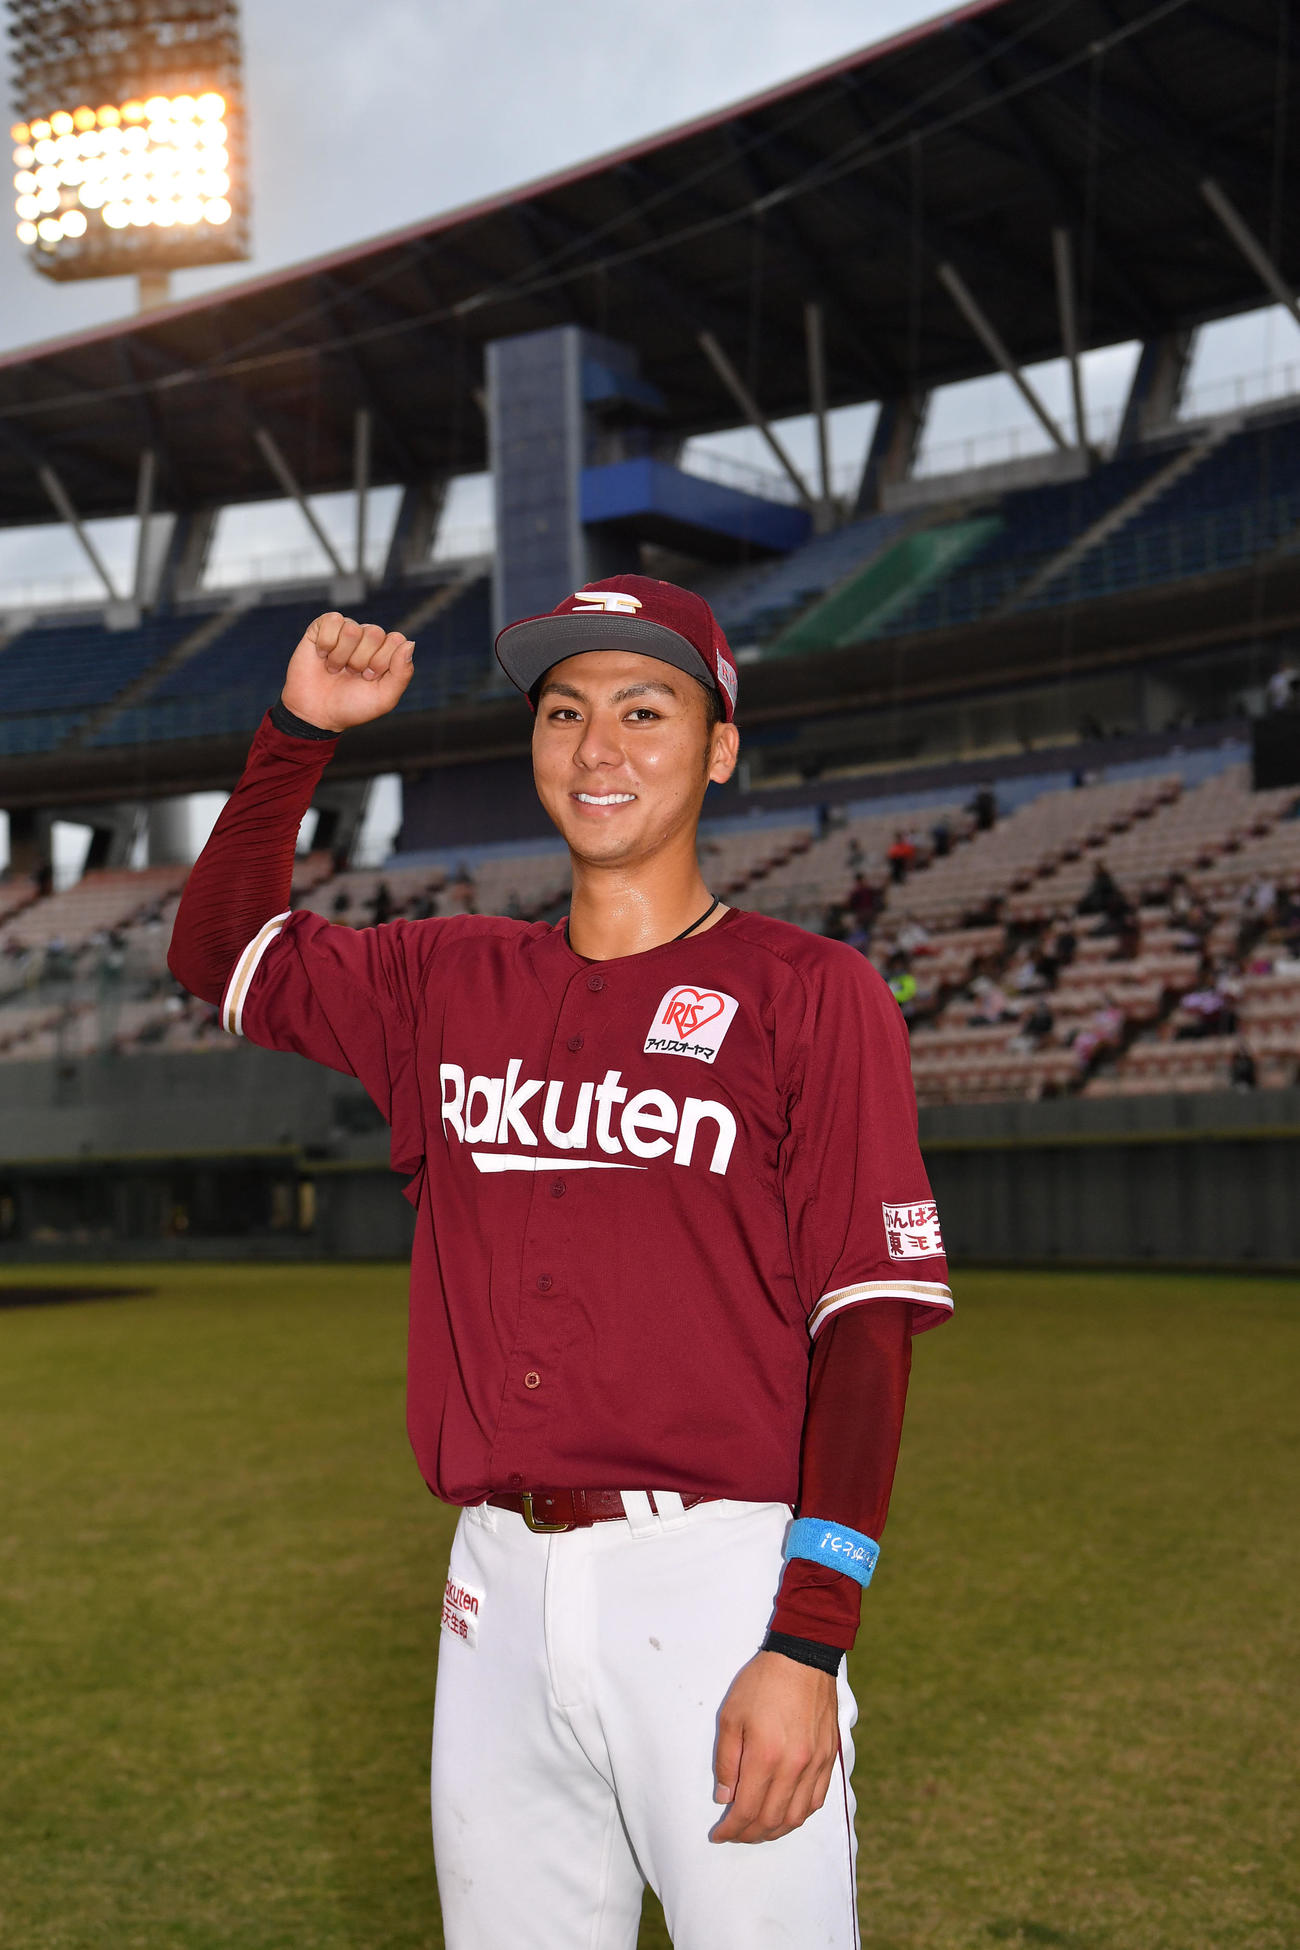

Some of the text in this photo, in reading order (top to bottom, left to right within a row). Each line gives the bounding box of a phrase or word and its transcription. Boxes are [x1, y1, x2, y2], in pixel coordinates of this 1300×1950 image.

[661, 1001, 704, 1028] IRIS
[645, 1038, 715, 1060] アイリスオーヤマ
[439, 1058, 737, 1175] Rakuten
[441, 1606, 469, 1643] 天生命
